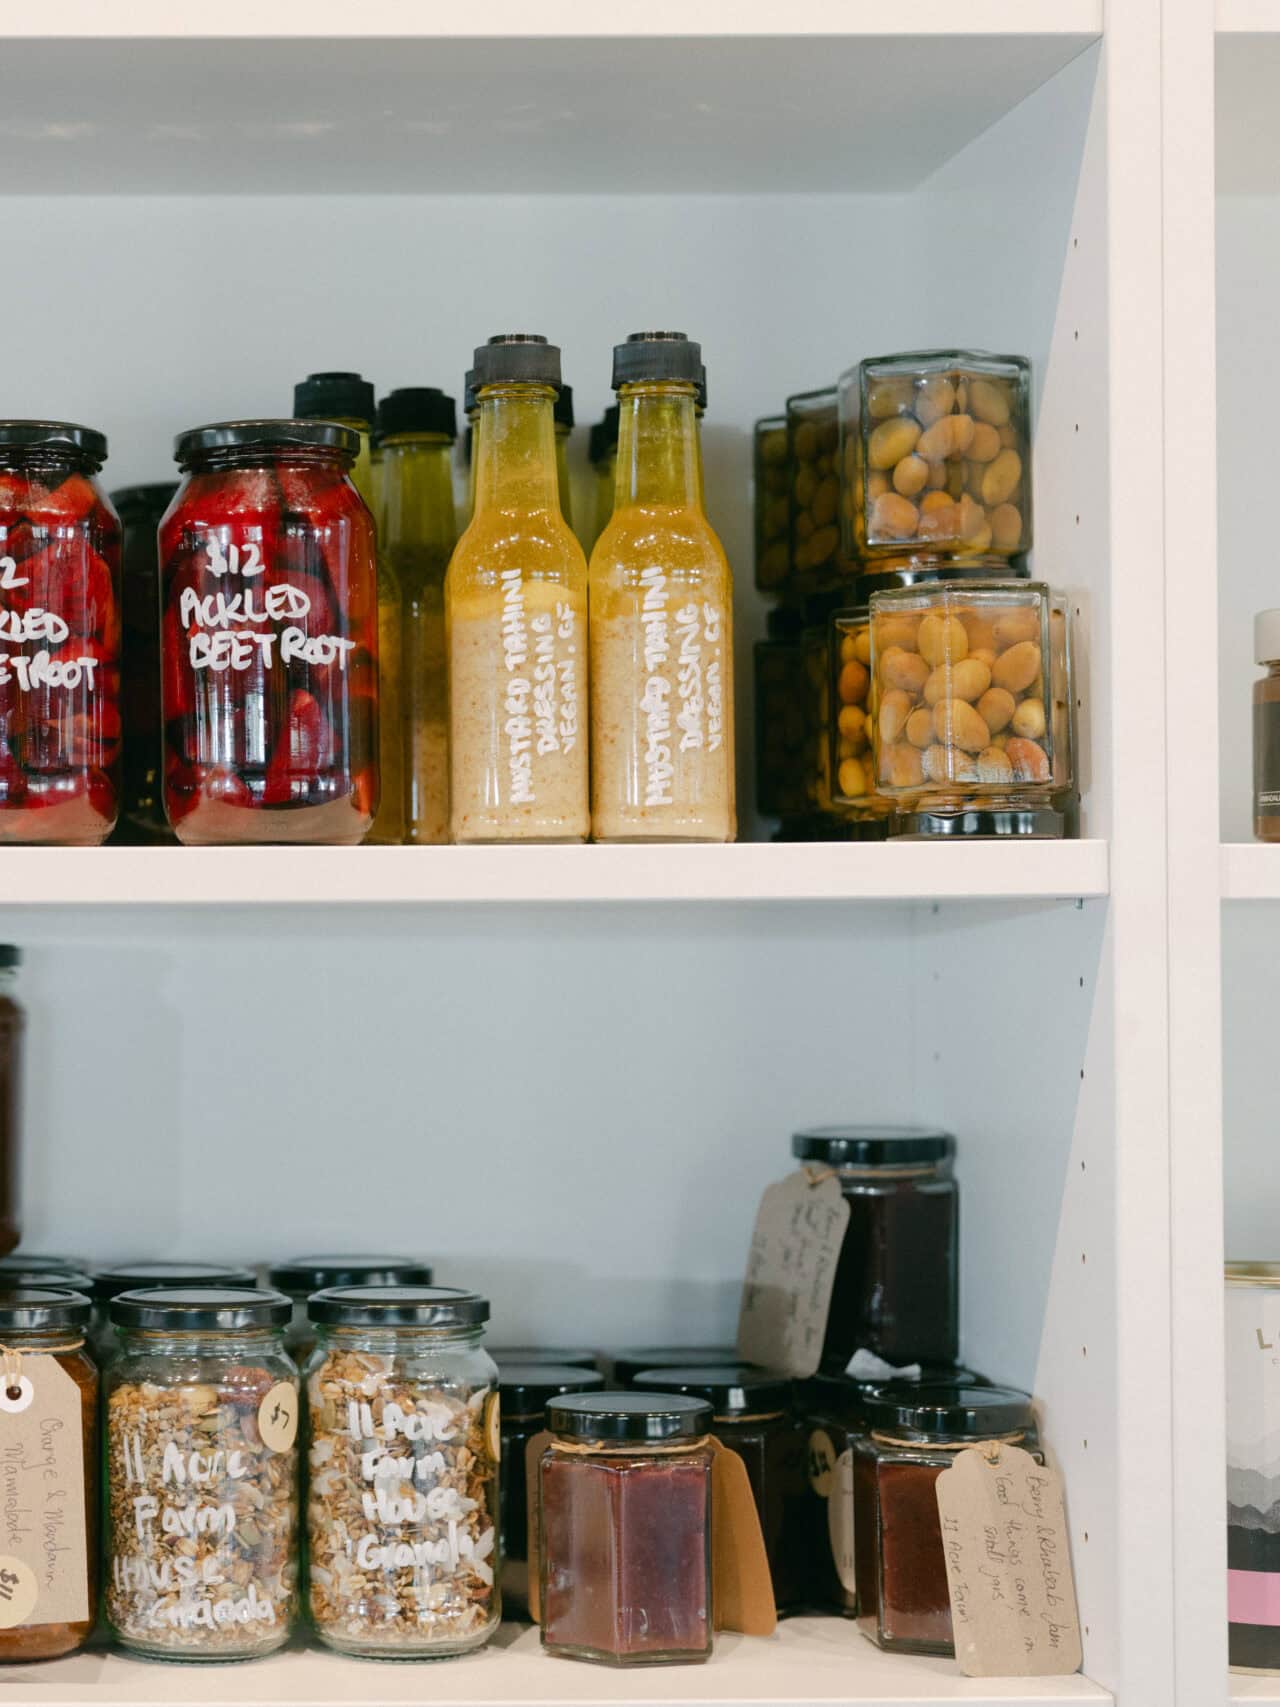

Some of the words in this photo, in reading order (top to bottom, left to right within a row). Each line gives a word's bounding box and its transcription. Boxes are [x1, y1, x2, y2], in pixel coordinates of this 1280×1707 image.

[205, 535, 266, 577] $12
[180, 584, 311, 629] PICKLED
[501, 568, 528, 671] TAHINI
[638, 566, 669, 672] TAHINI
[531, 611, 560, 756] DRESSING
[675, 603, 703, 752] DRESSING
[503, 678, 536, 805] MUSTARD
[640, 676, 673, 806] MUSTARD
[1255, 1327, 1280, 1350] L
[271, 1402, 290, 1429] $7
[348, 1400, 373, 1441] 11
[382, 1402, 456, 1441] Acre
[122, 1432, 146, 1485] 11
[162, 1441, 248, 1485] Acre
[361, 1449, 445, 1480] Farm
[0, 1442, 33, 1548] Marmalade
[21, 1418, 65, 1480] Orange
[43, 1508, 72, 1592] Mandarin
[133, 1495, 237, 1539] Farm
[361, 1486, 463, 1523] House
[985, 1527, 1006, 1563] small
[1023, 1476, 1049, 1519] Berry
[1041, 1612, 1071, 1648] Jam
[112, 1555, 225, 1594] House
[1004, 1520, 1023, 1566] things
[1014, 1578, 1032, 1617] come
[1023, 1637, 1035, 1653] in
[150, 1583, 276, 1630] Granola
